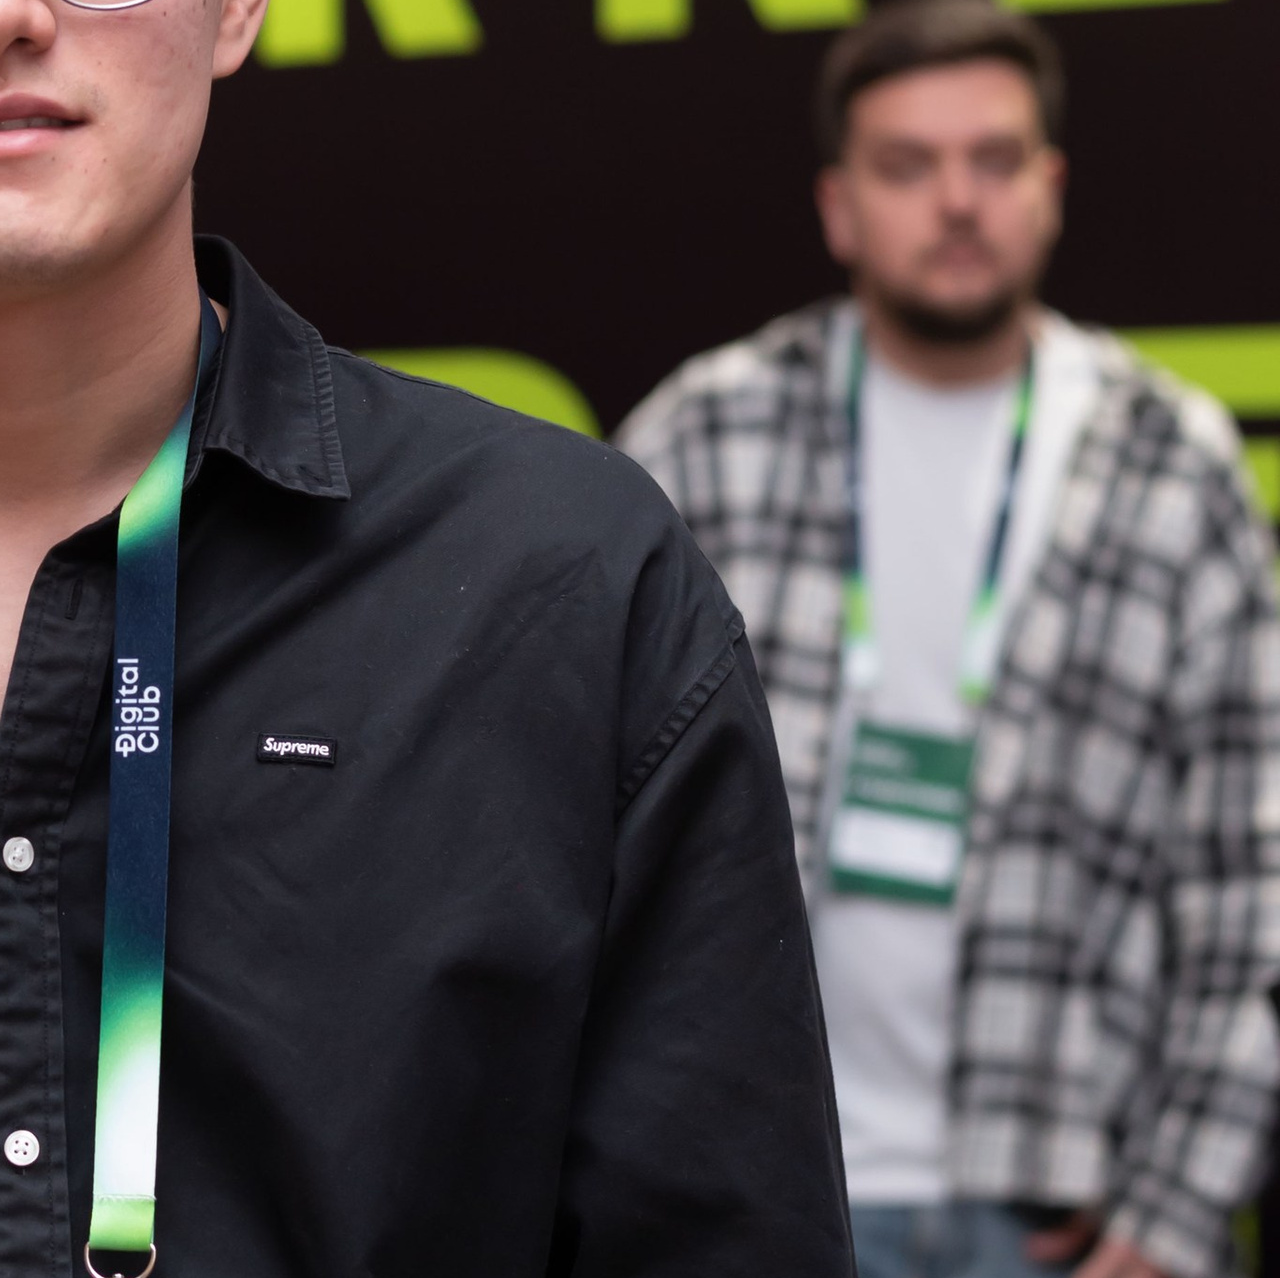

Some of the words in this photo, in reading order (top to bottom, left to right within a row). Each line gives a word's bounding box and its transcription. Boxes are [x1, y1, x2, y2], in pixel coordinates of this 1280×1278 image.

[115, 658, 143, 758] Digital
[137, 686, 161, 753] Club
[263, 737, 329, 756] Supreme
